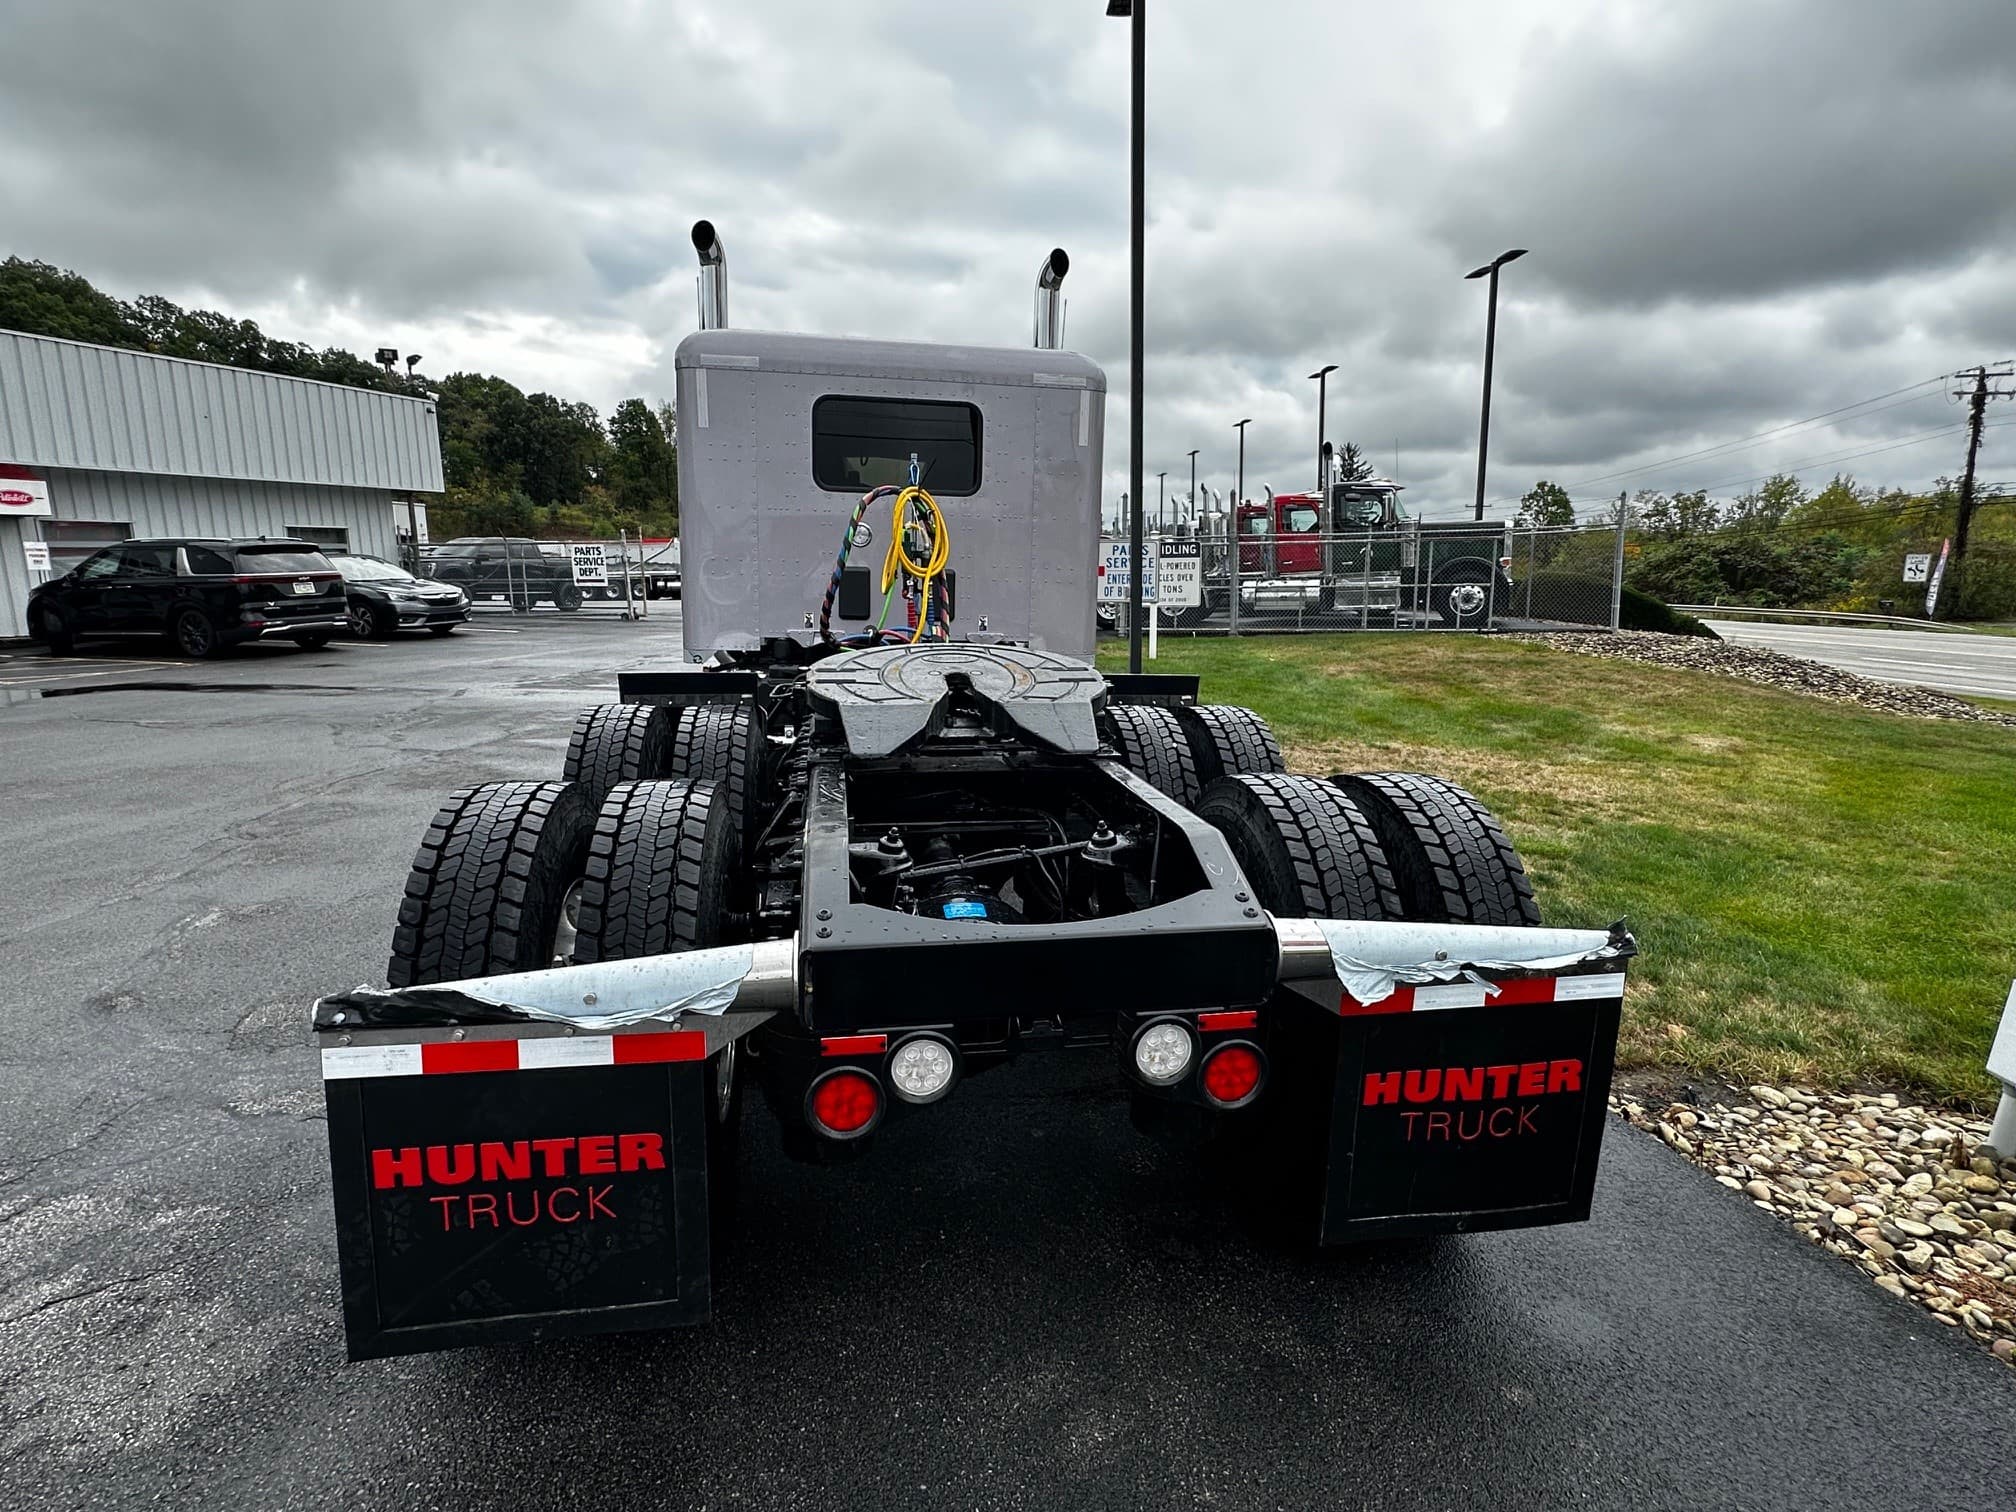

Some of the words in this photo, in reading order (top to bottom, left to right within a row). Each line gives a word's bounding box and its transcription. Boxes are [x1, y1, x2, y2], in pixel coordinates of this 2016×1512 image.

[574, 546, 602, 556] PARTS
[1112, 545, 1149, 556] PAS
[1162, 544, 1197, 554] IDLING
[573, 557, 605, 566] SERVICE
[1106, 557, 1155, 569] SERCE
[579, 567, 602, 577] DEPT.
[1177, 573, 1194, 582] OVER
[1104, 586, 1114, 597] OF
[1163, 585, 1183, 594] TONS
[1362, 1058, 1583, 1107] HUNTER
[1400, 1104, 1540, 1142] TRUCK
[371, 1132, 666, 1190] HUNTER
[429, 1184, 618, 1233] TRUCK
